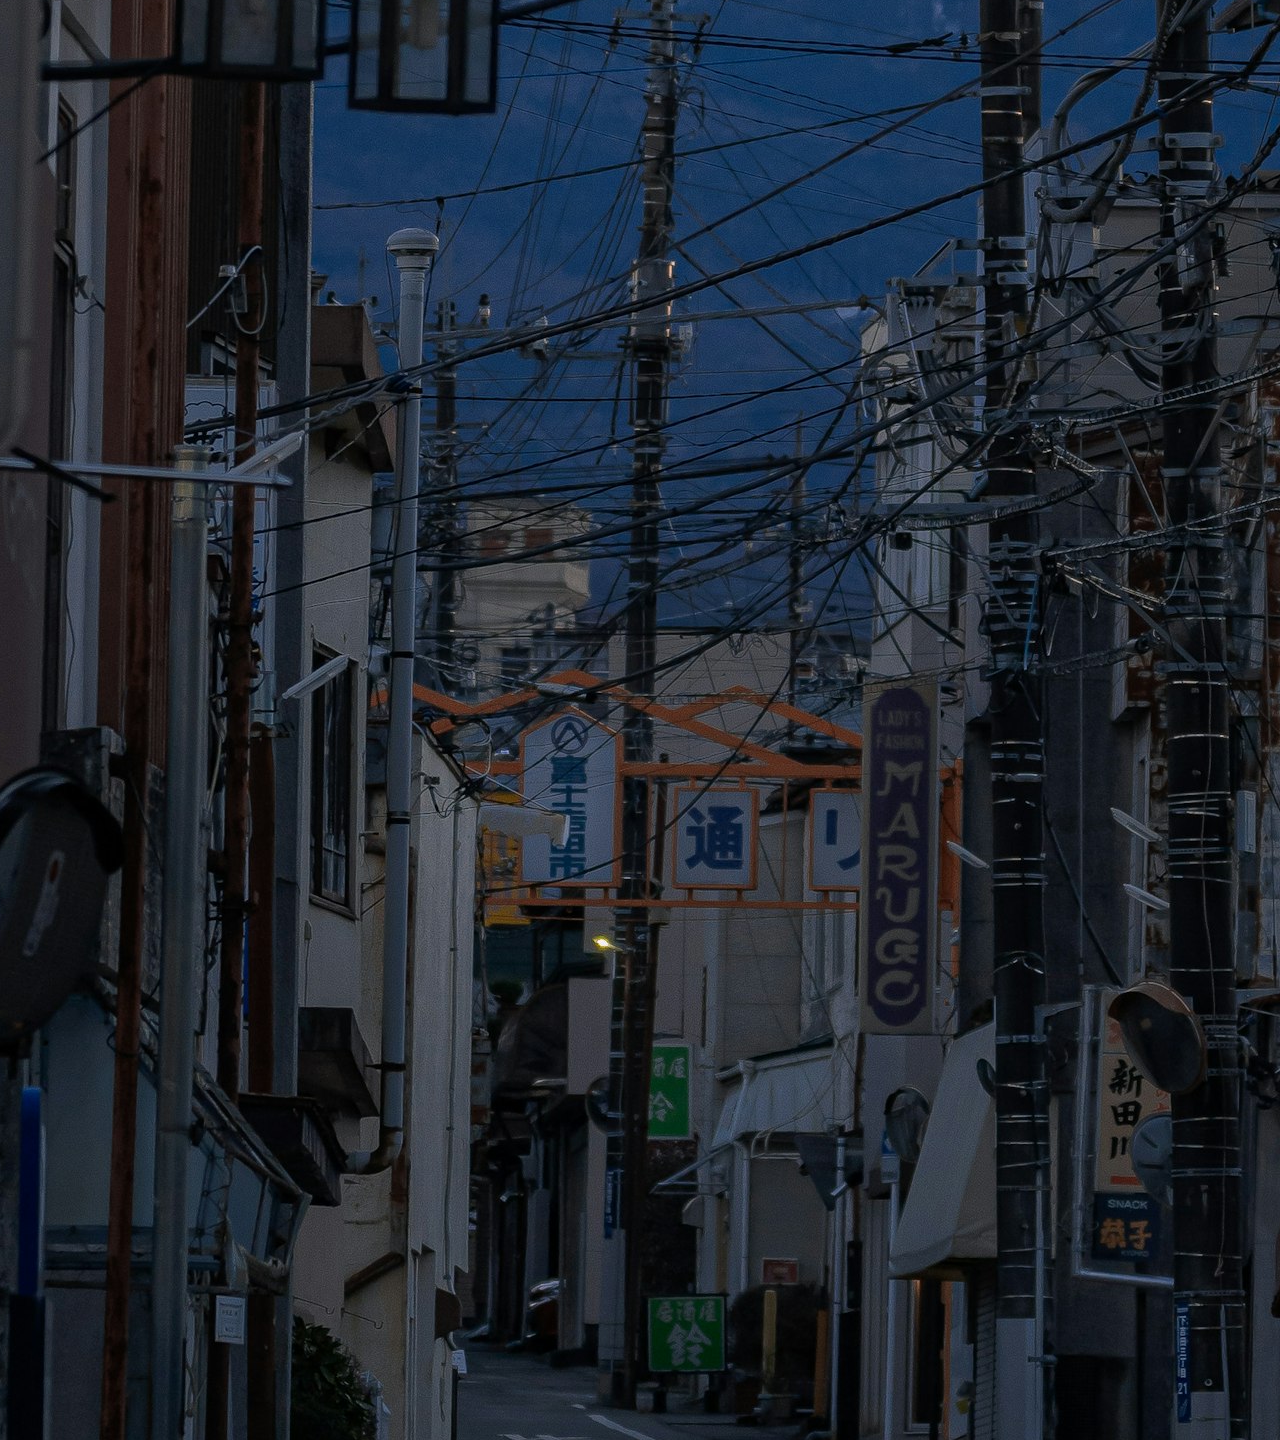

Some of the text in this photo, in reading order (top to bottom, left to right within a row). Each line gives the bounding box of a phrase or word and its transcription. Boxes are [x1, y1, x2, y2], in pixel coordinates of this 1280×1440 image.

[1107, 1199, 1149, 1210] SNACK
[666, 1322, 712, 1367] 鈴
[1177, 1382, 1188, 1395] 21
